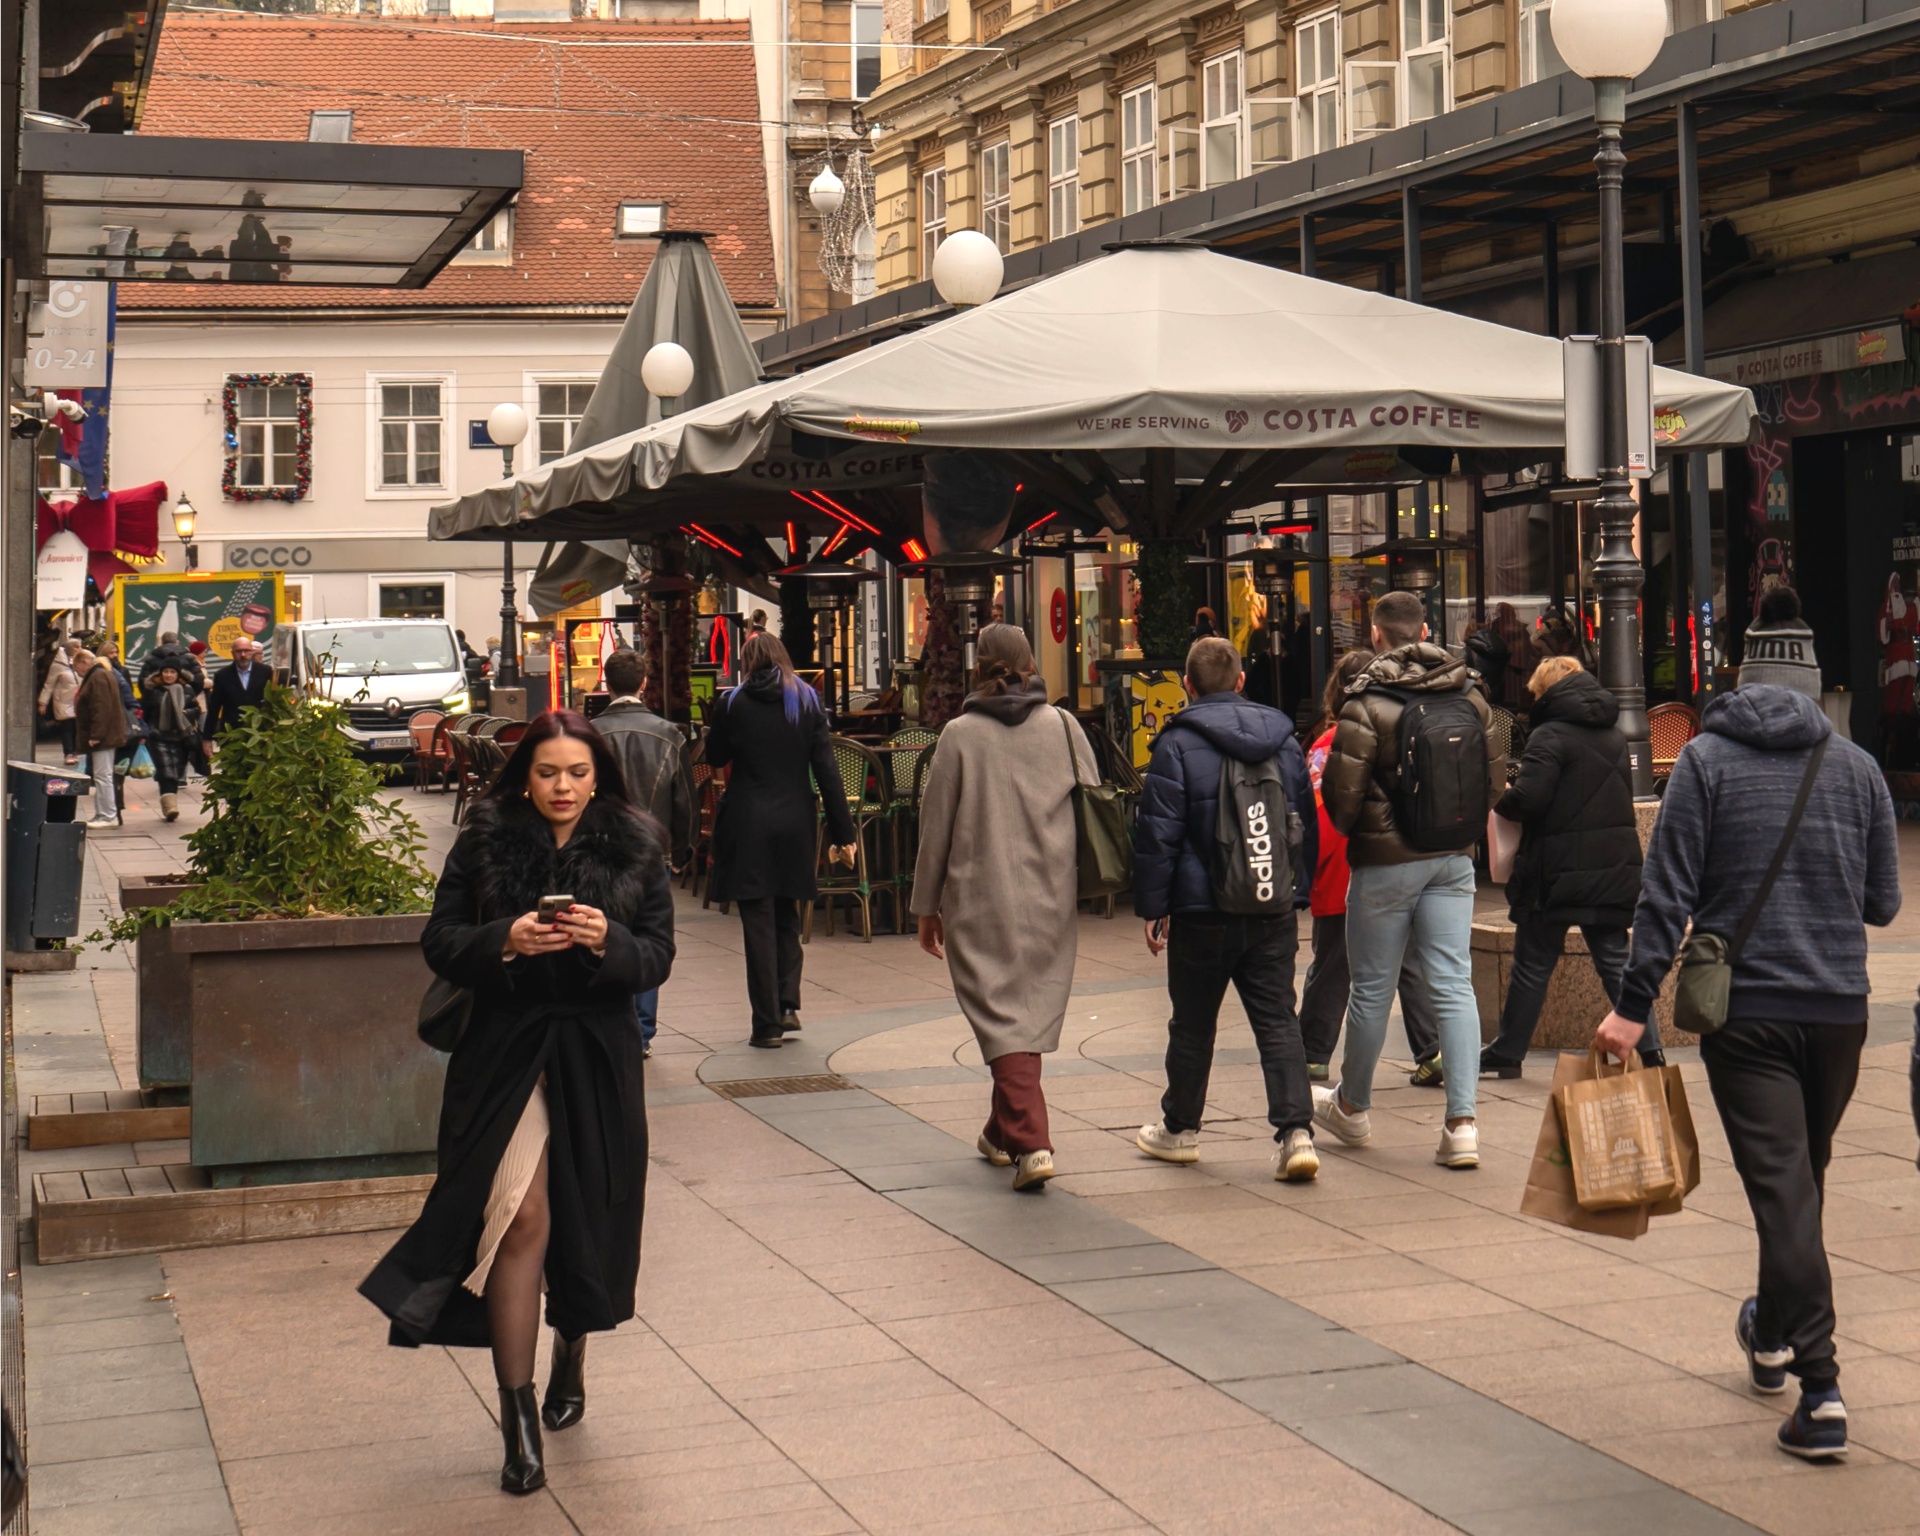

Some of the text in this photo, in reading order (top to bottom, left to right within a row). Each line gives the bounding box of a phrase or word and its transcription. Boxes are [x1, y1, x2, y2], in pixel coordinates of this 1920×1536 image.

[34, 348, 96, 370] 0-24
[1748, 359, 1780, 376] COSTA
[1783, 349, 1823, 370] COFFEE
[1078, 405, 1481, 433] WE'RE SERVING COSTA COFFEE
[751, 453, 925, 480] COSTA COFFE
[230, 546, 312, 567] ecco
[218, 642, 233, 651] TON
[1246, 801, 1274, 902] adidas
